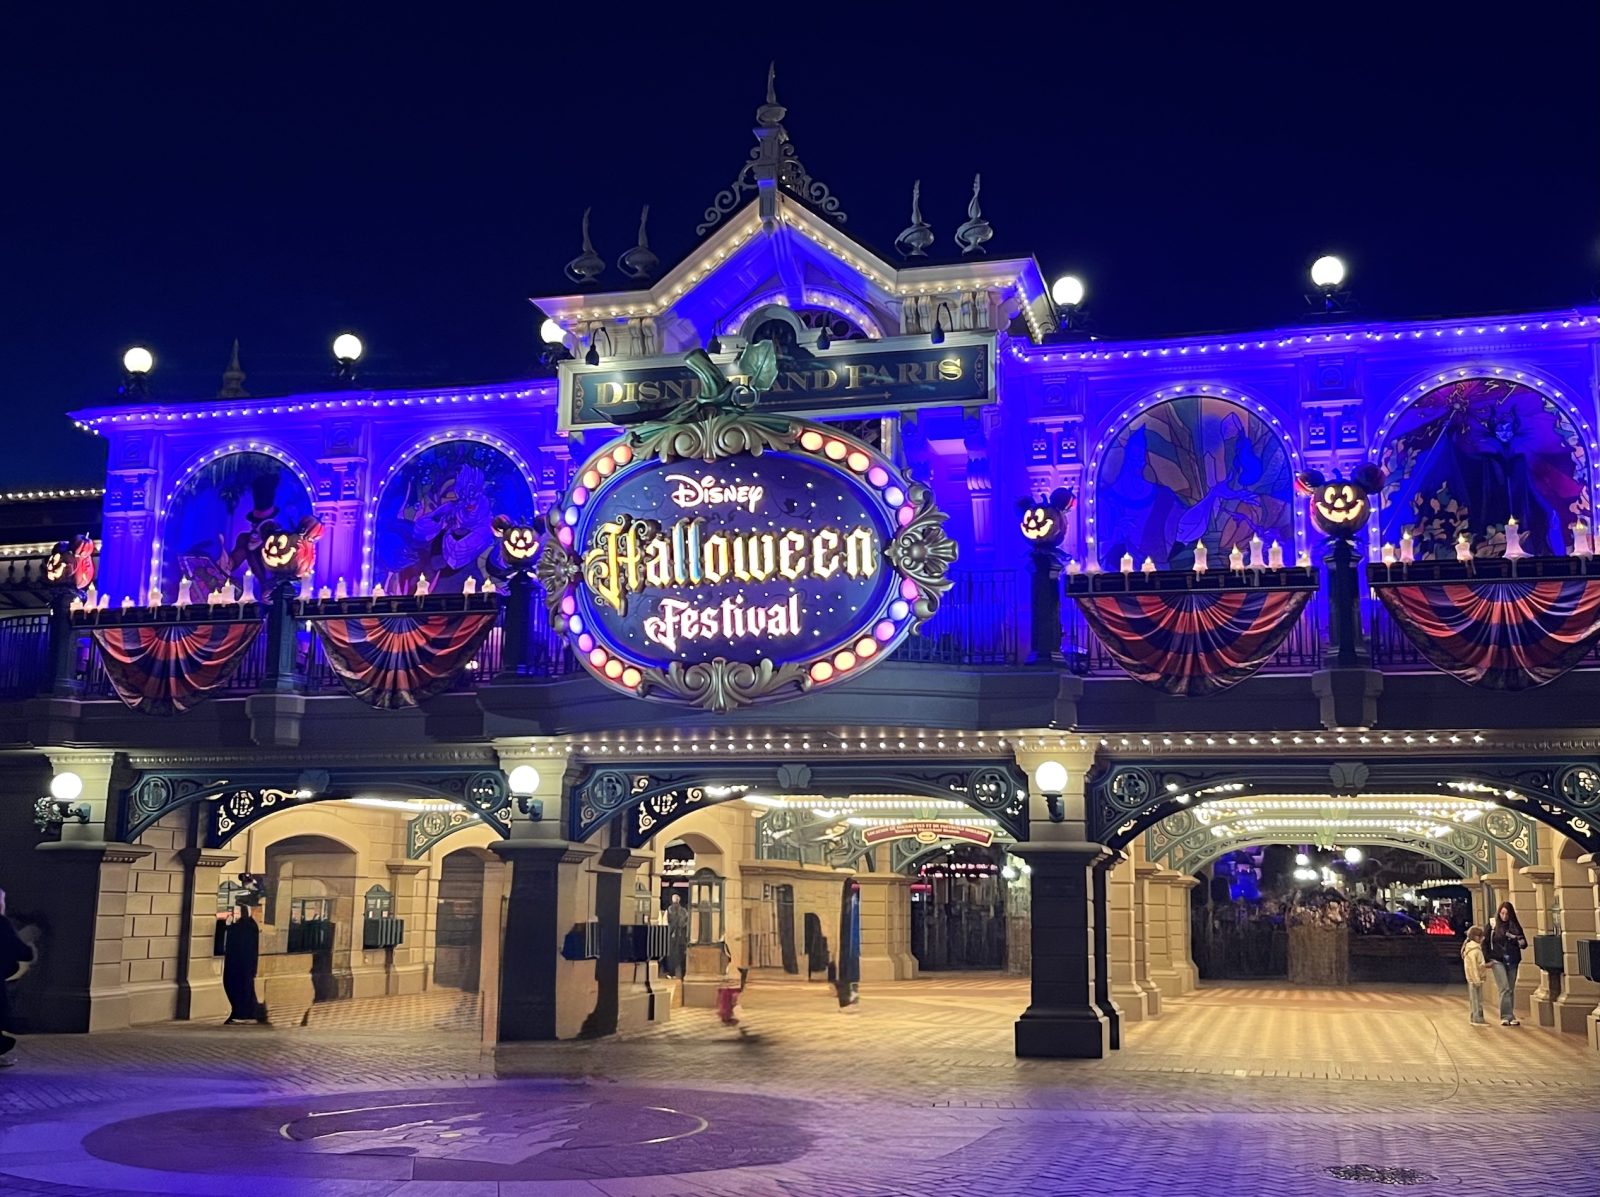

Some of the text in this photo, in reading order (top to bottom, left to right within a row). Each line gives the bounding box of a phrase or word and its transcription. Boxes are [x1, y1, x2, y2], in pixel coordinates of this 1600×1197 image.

[844, 358, 963, 390] PARIS
[582, 514, 878, 617] Halloween
[643, 594, 802, 653] Festival
